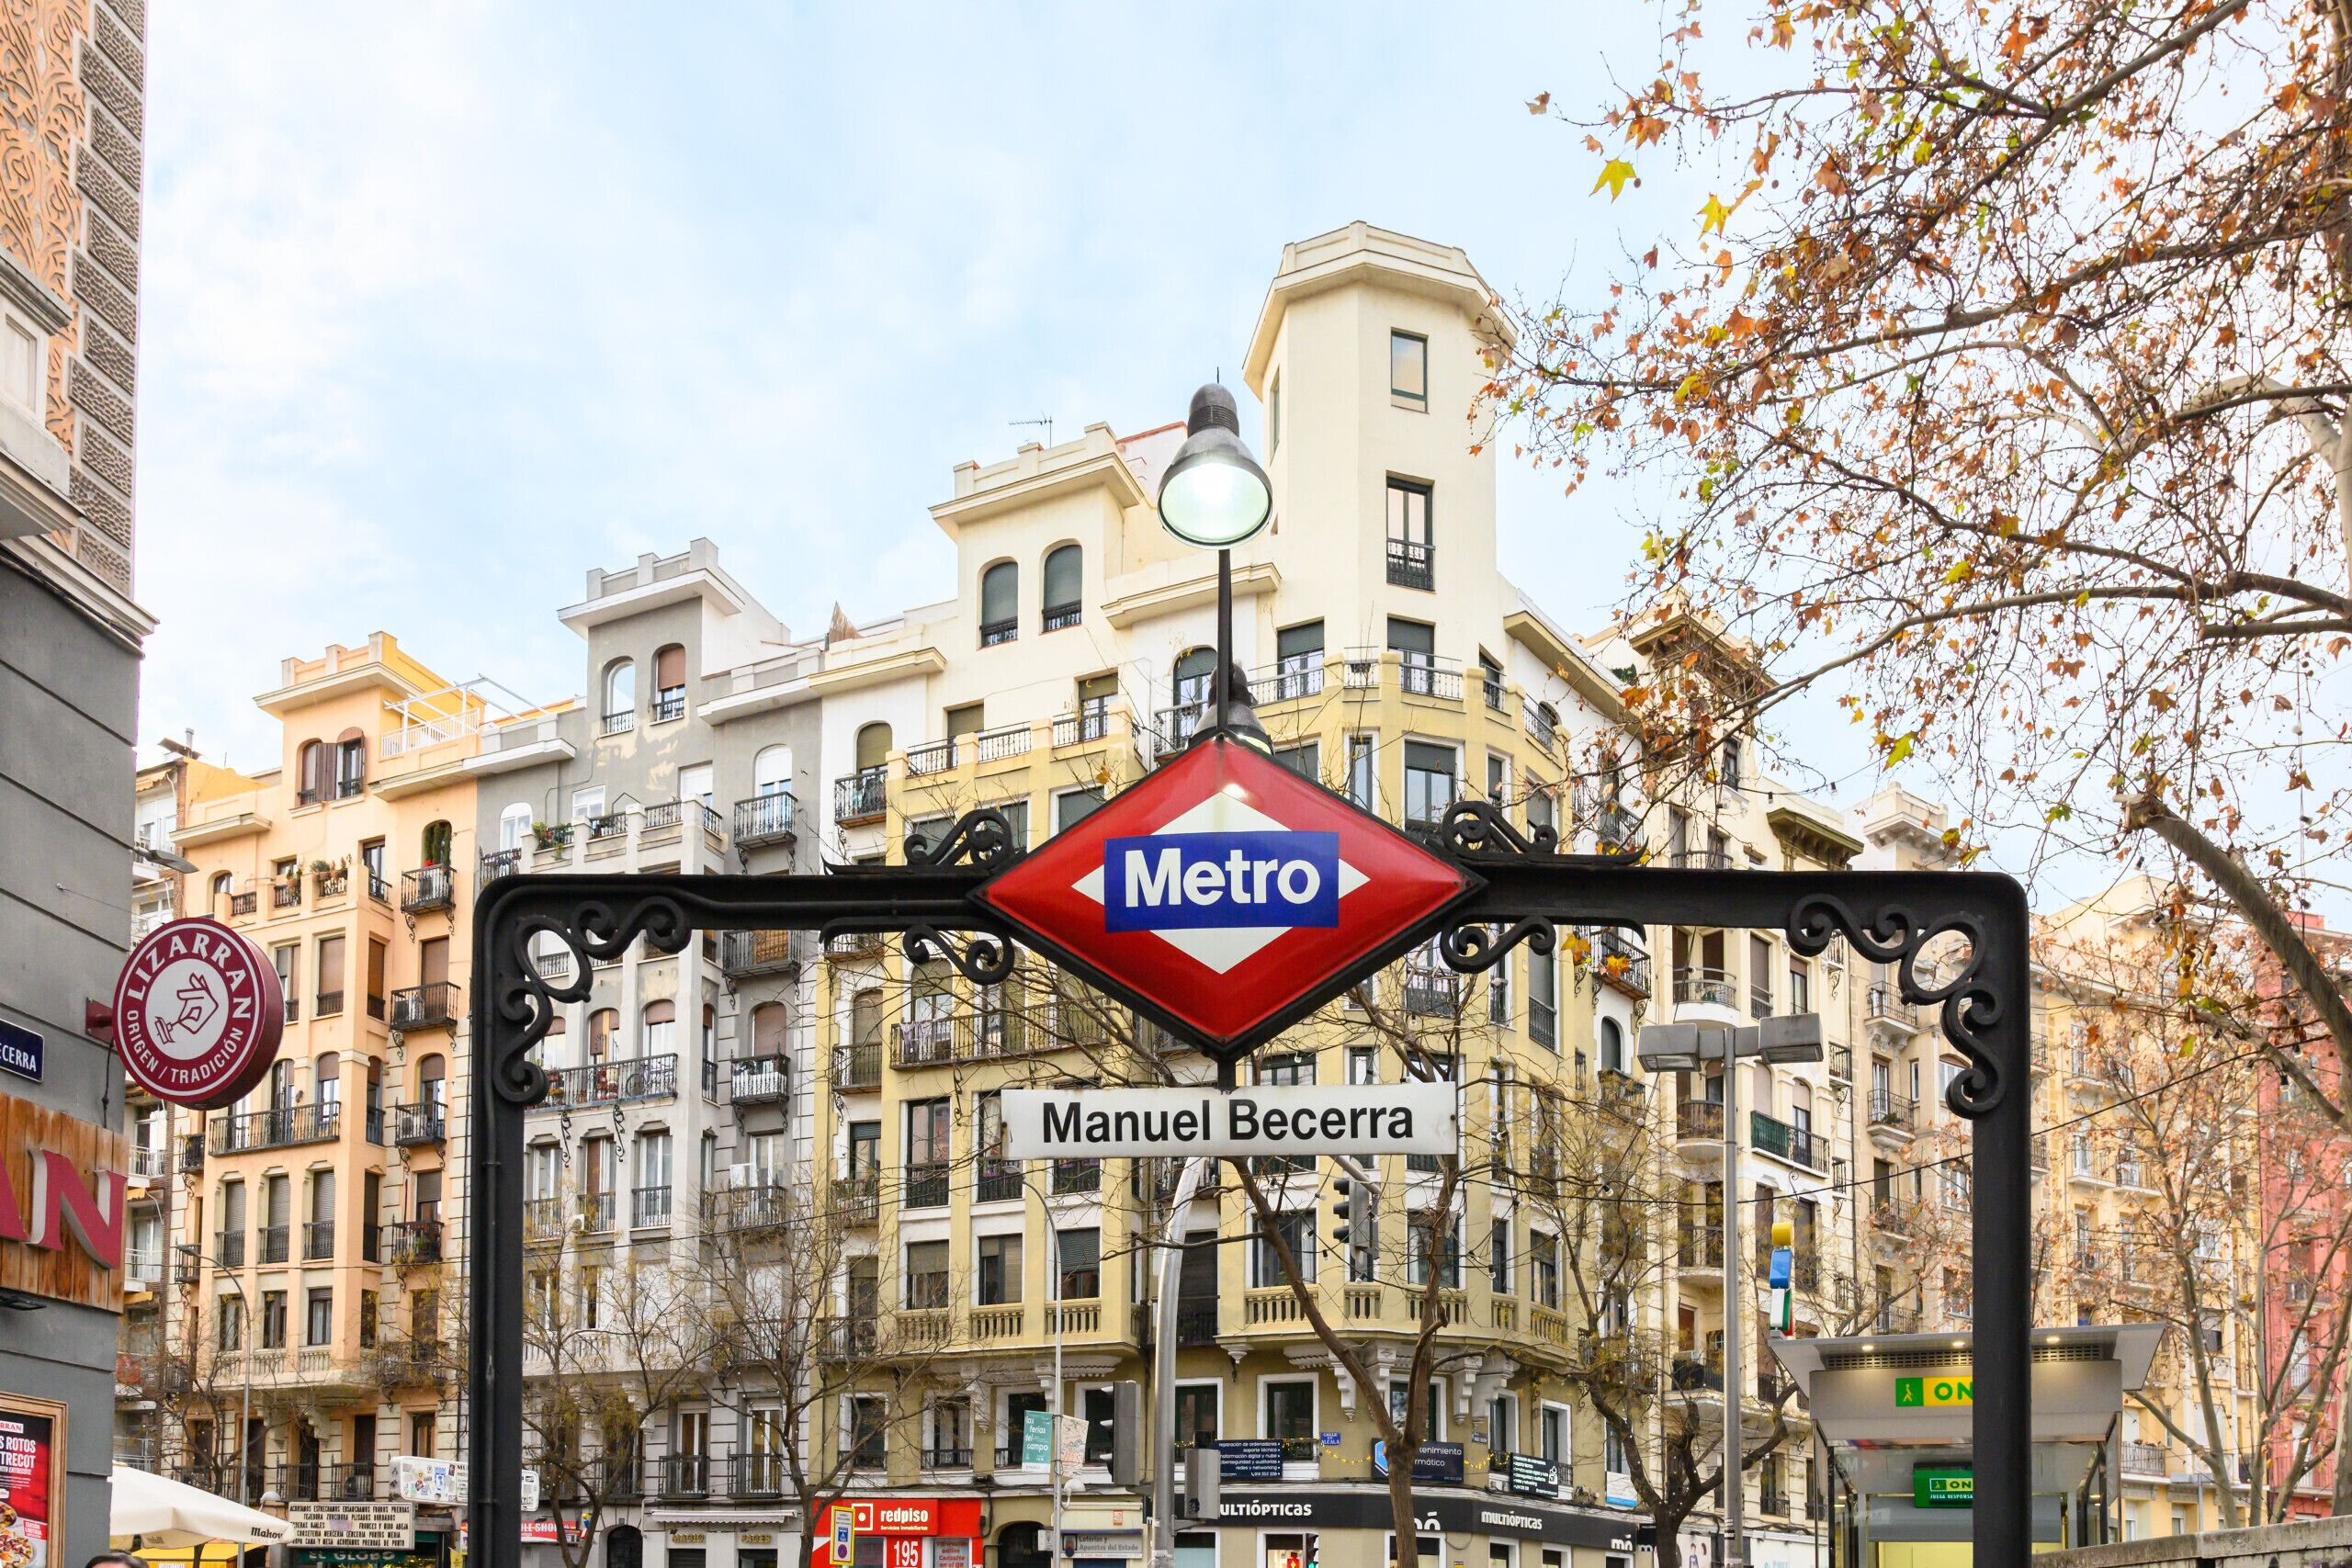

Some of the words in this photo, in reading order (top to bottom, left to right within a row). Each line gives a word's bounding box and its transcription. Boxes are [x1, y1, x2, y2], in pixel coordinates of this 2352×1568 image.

[1124, 847, 1321, 908] Metro
[127, 932, 252, 1020] LIZARRAN
[126, 1010, 159, 1073] ORIGEN
[171, 1027, 244, 1084] TRADICIÓN
[1042, 1099, 1211, 1144] Manuel
[1228, 1098, 1414, 1141] Becerra
[1934, 1382, 1973, 1401] ON
[6, 1437, 36, 1453] ROTOS
[1026, 1443, 1048, 1452] campo
[1415, 1459, 1445, 1467] rmático
[880, 1507, 929, 1523] redpiso
[894, 1540, 918, 1567] 195
